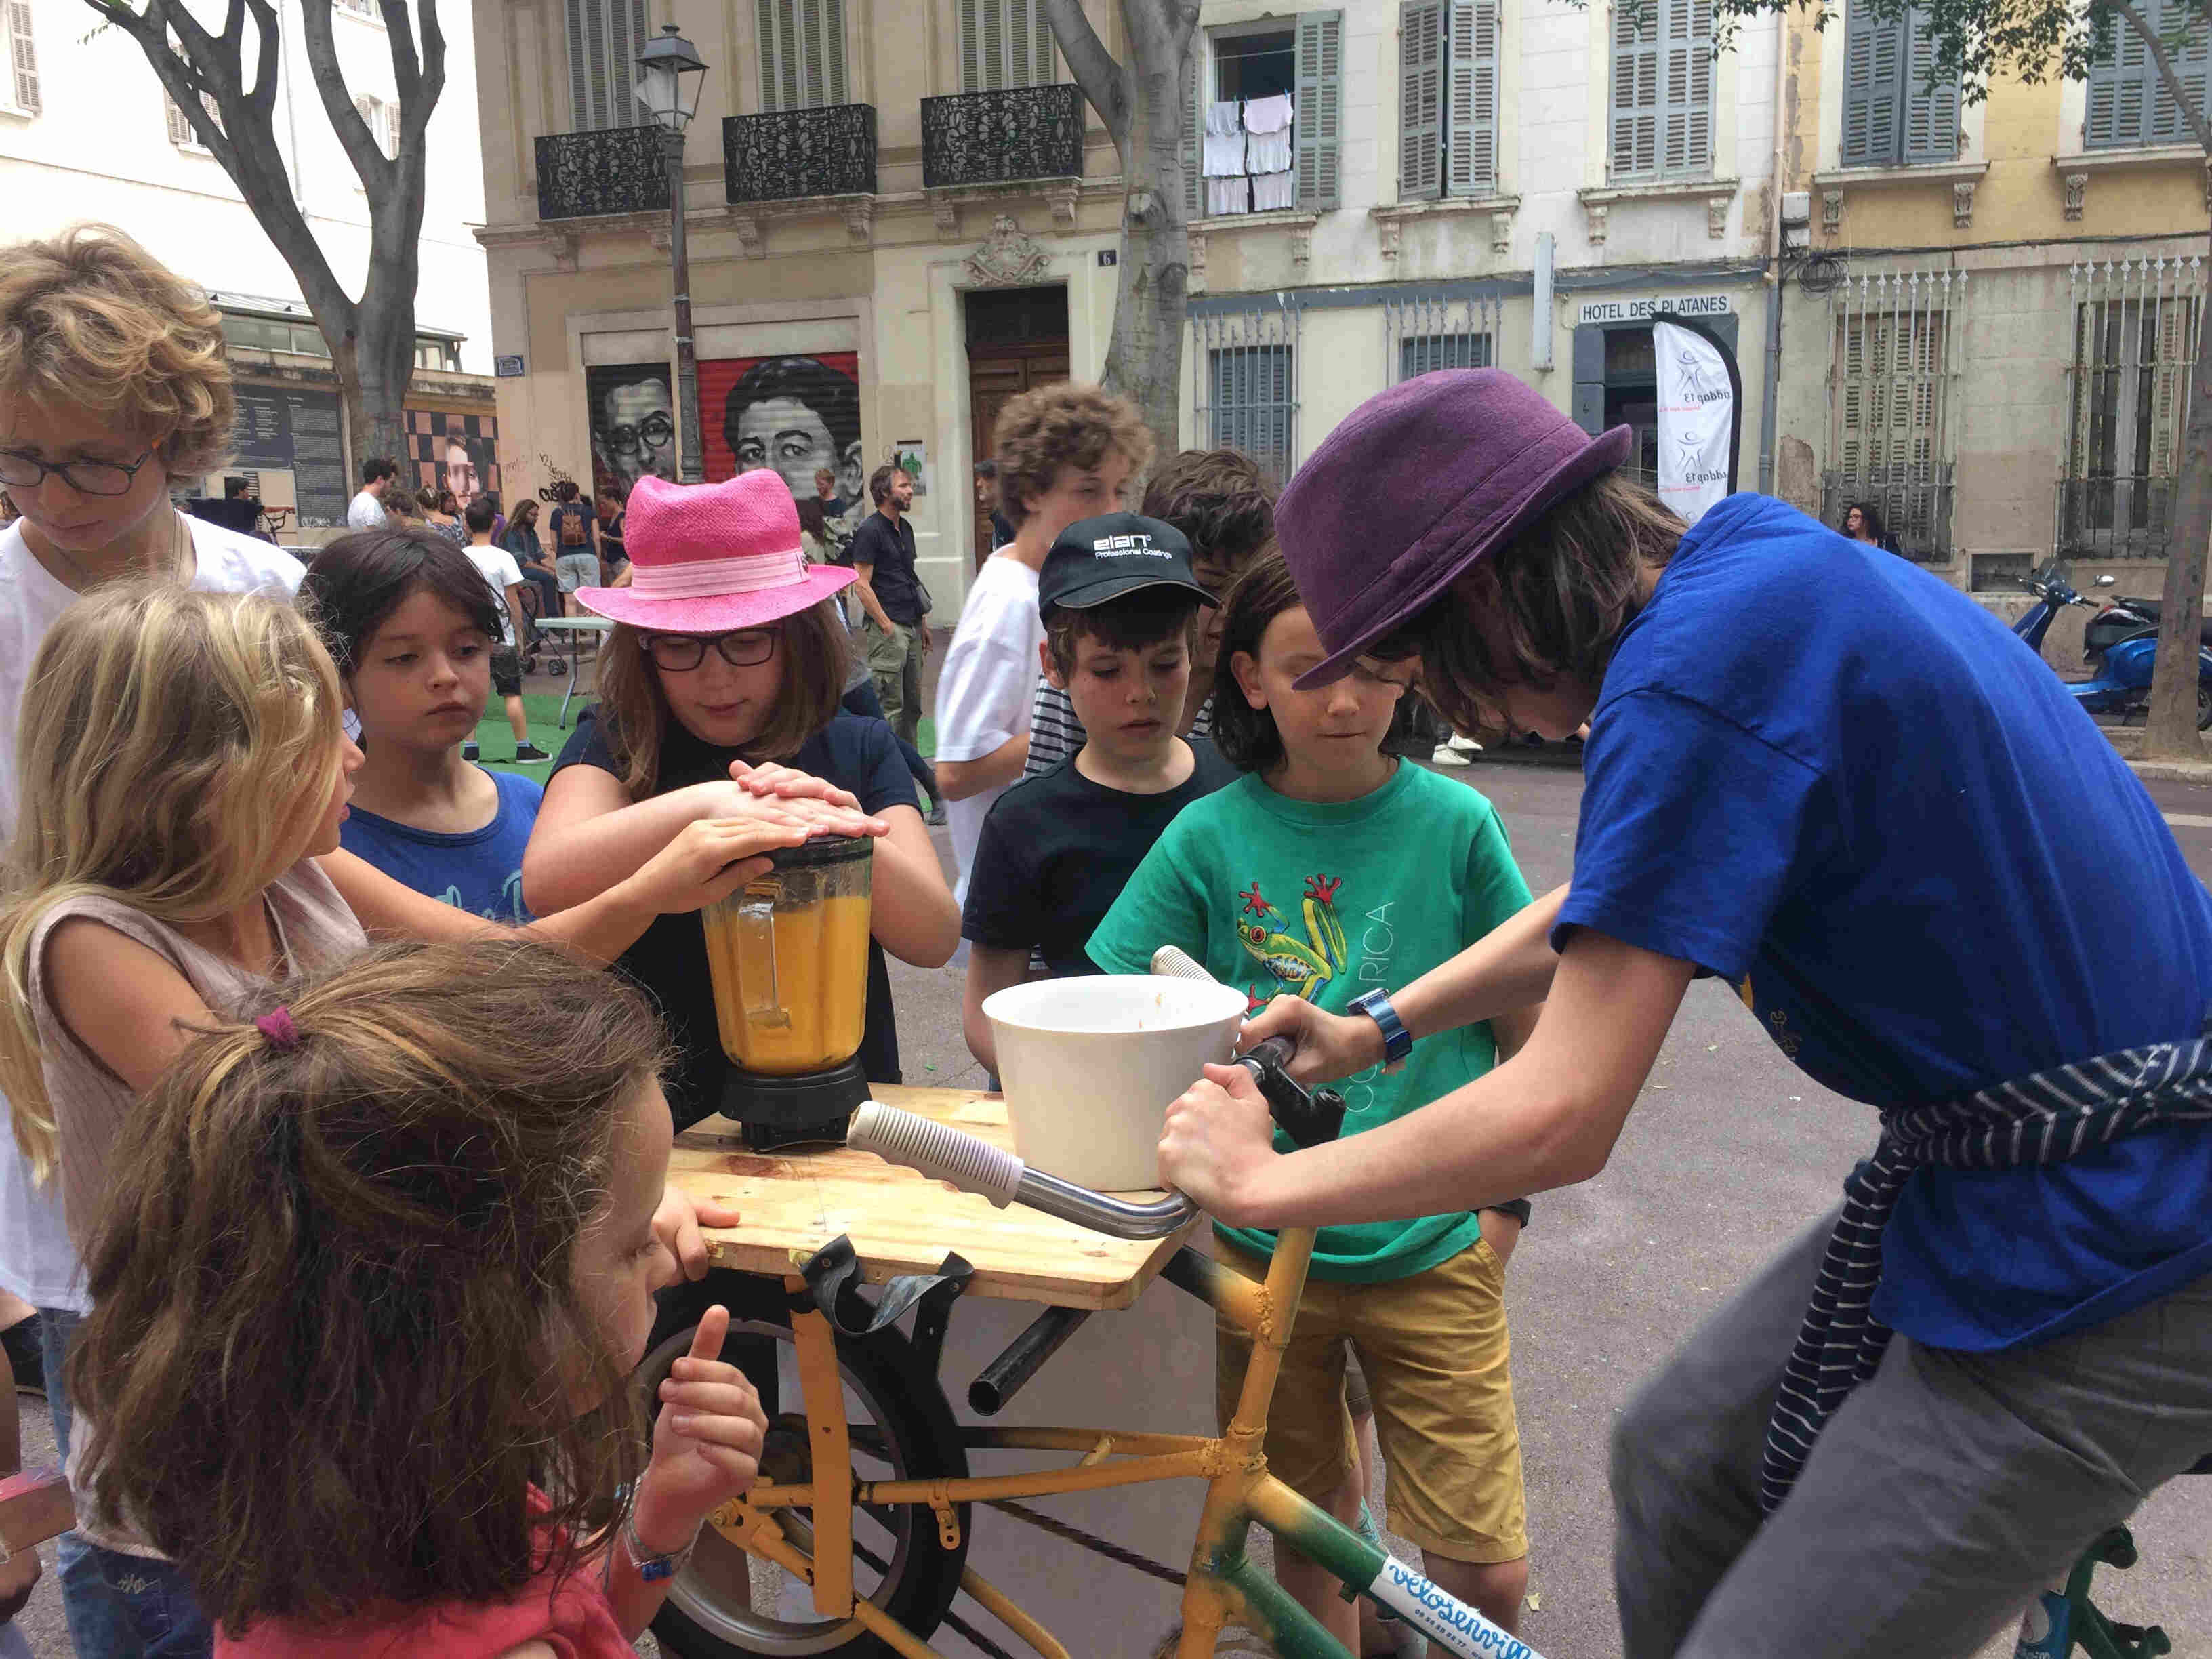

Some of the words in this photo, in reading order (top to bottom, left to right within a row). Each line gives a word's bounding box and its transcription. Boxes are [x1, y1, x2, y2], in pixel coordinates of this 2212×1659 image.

[1583, 304, 1624, 320] HOTEL
[1630, 301, 1655, 316] DES
[1662, 295, 1727, 314] PLATANES
[1094, 548, 1141, 560] Professional
[1359, 901, 1396, 981] RICA
